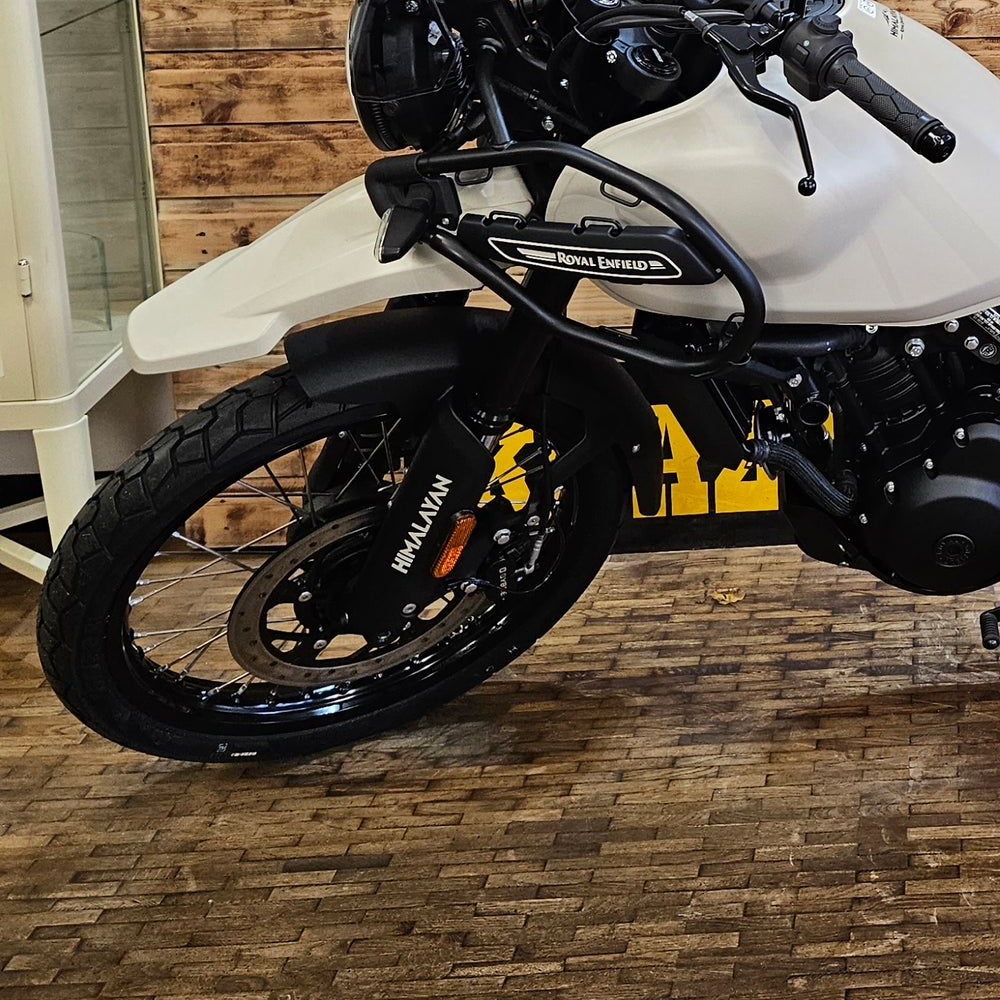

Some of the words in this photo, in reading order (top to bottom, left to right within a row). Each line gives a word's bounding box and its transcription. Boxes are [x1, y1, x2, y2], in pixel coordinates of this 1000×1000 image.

[557, 251, 596, 267] ROYAL
[598, 256, 649, 271] ENFIELD
[391, 474, 453, 575] HIMALAYAN
